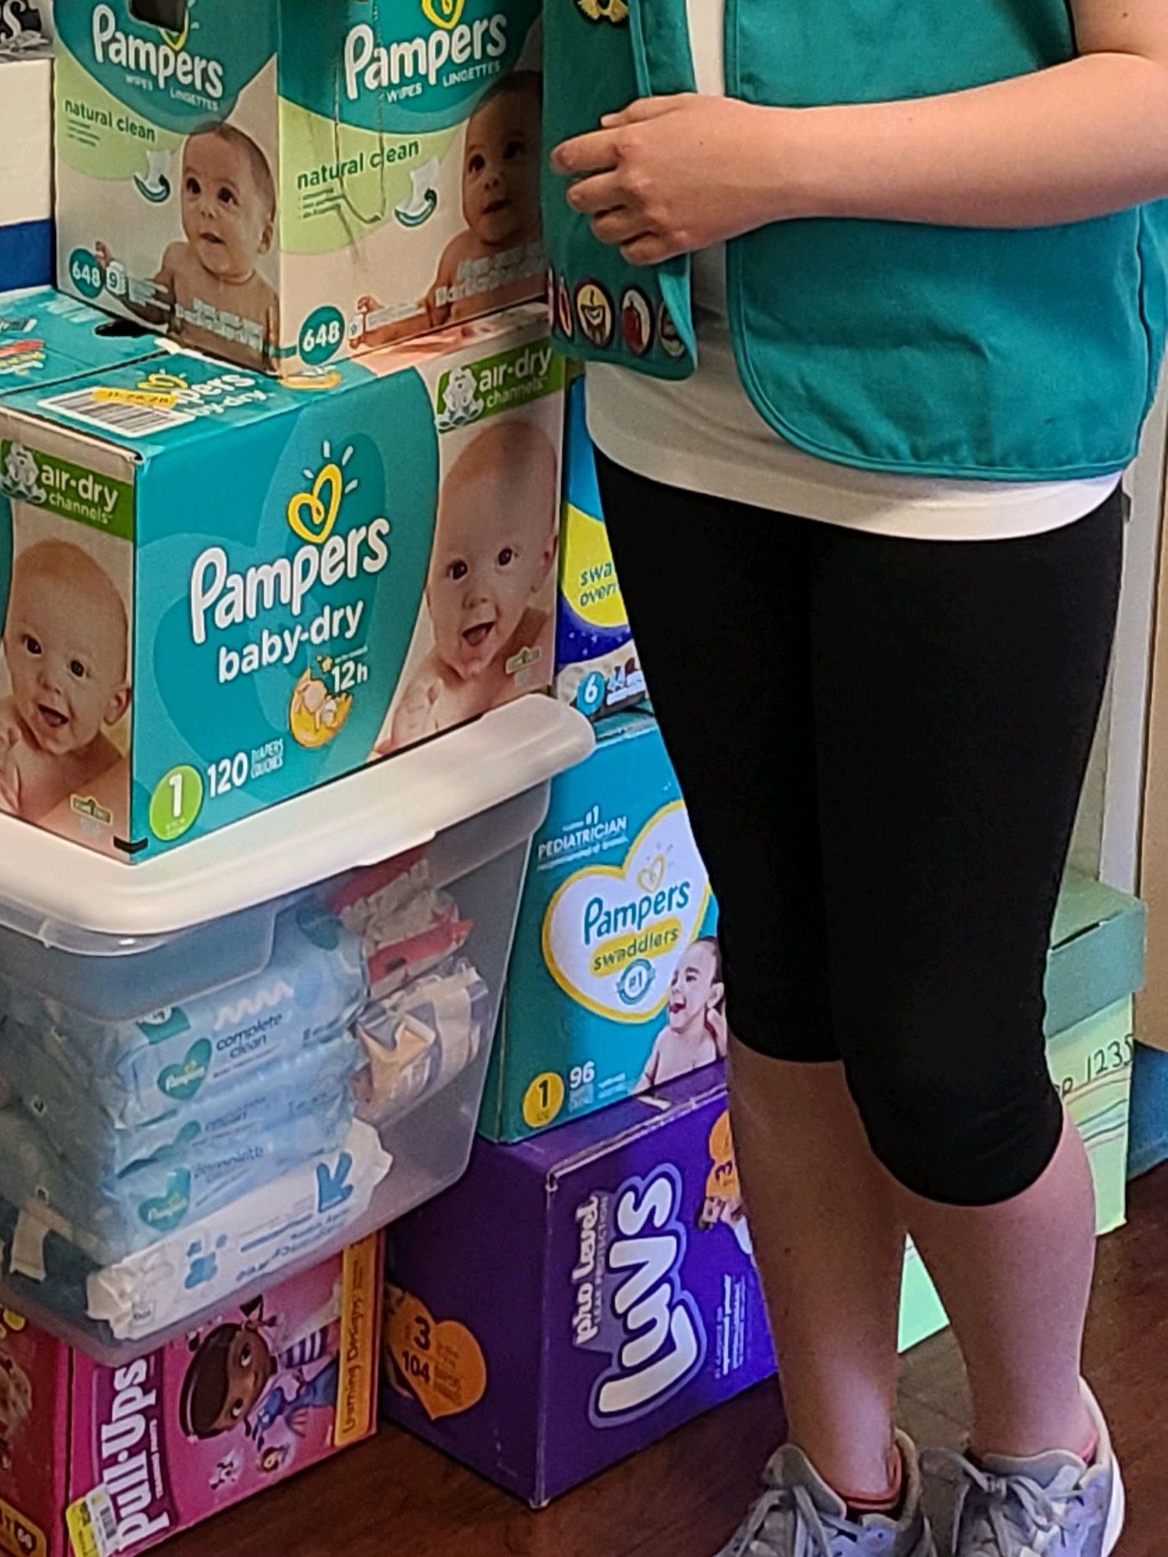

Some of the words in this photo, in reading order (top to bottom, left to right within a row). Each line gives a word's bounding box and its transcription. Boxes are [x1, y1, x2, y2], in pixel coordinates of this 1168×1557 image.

[92, 3, 223, 99] Pampers
[344, 13, 508, 101] Pampers
[125, 74, 154, 92] WIPES
[170, 87, 220, 112] LINGETTES
[385, 81, 423, 104] WIPES
[441, 59, 501, 88] LINGETTES
[64, 99, 113, 128] natural
[116, 115, 156, 143] clean
[296, 152, 364, 191] natural
[369, 139, 420, 169] clean
[72, 260, 101, 287] 648
[302, 320, 341, 353] 648
[485, 379, 544, 409] channels
[47, 493, 110, 526] channels
[189, 516, 391, 645] Pampers
[218, 600, 365, 685] baby-dry
[330, 661, 369, 693] 12h
[585, 674, 598, 704] 6
[206, 750, 249, 798] 120
[168, 773, 184, 819] 1
[537, 815, 628, 861] PEDIATRICIAN
[584, 880, 691, 946] Pampers
[593, 927, 680, 972] swaddlers
[215, 1012, 283, 1053] complete
[229, 1034, 268, 1060] clean
[569, 1059, 596, 1090] 96
[1087, 1033, 1134, 1084] 1235
[536, 1079, 550, 1108] 1
[414, 1316, 431, 1351] 3
[401, 1350, 432, 1385] 104
